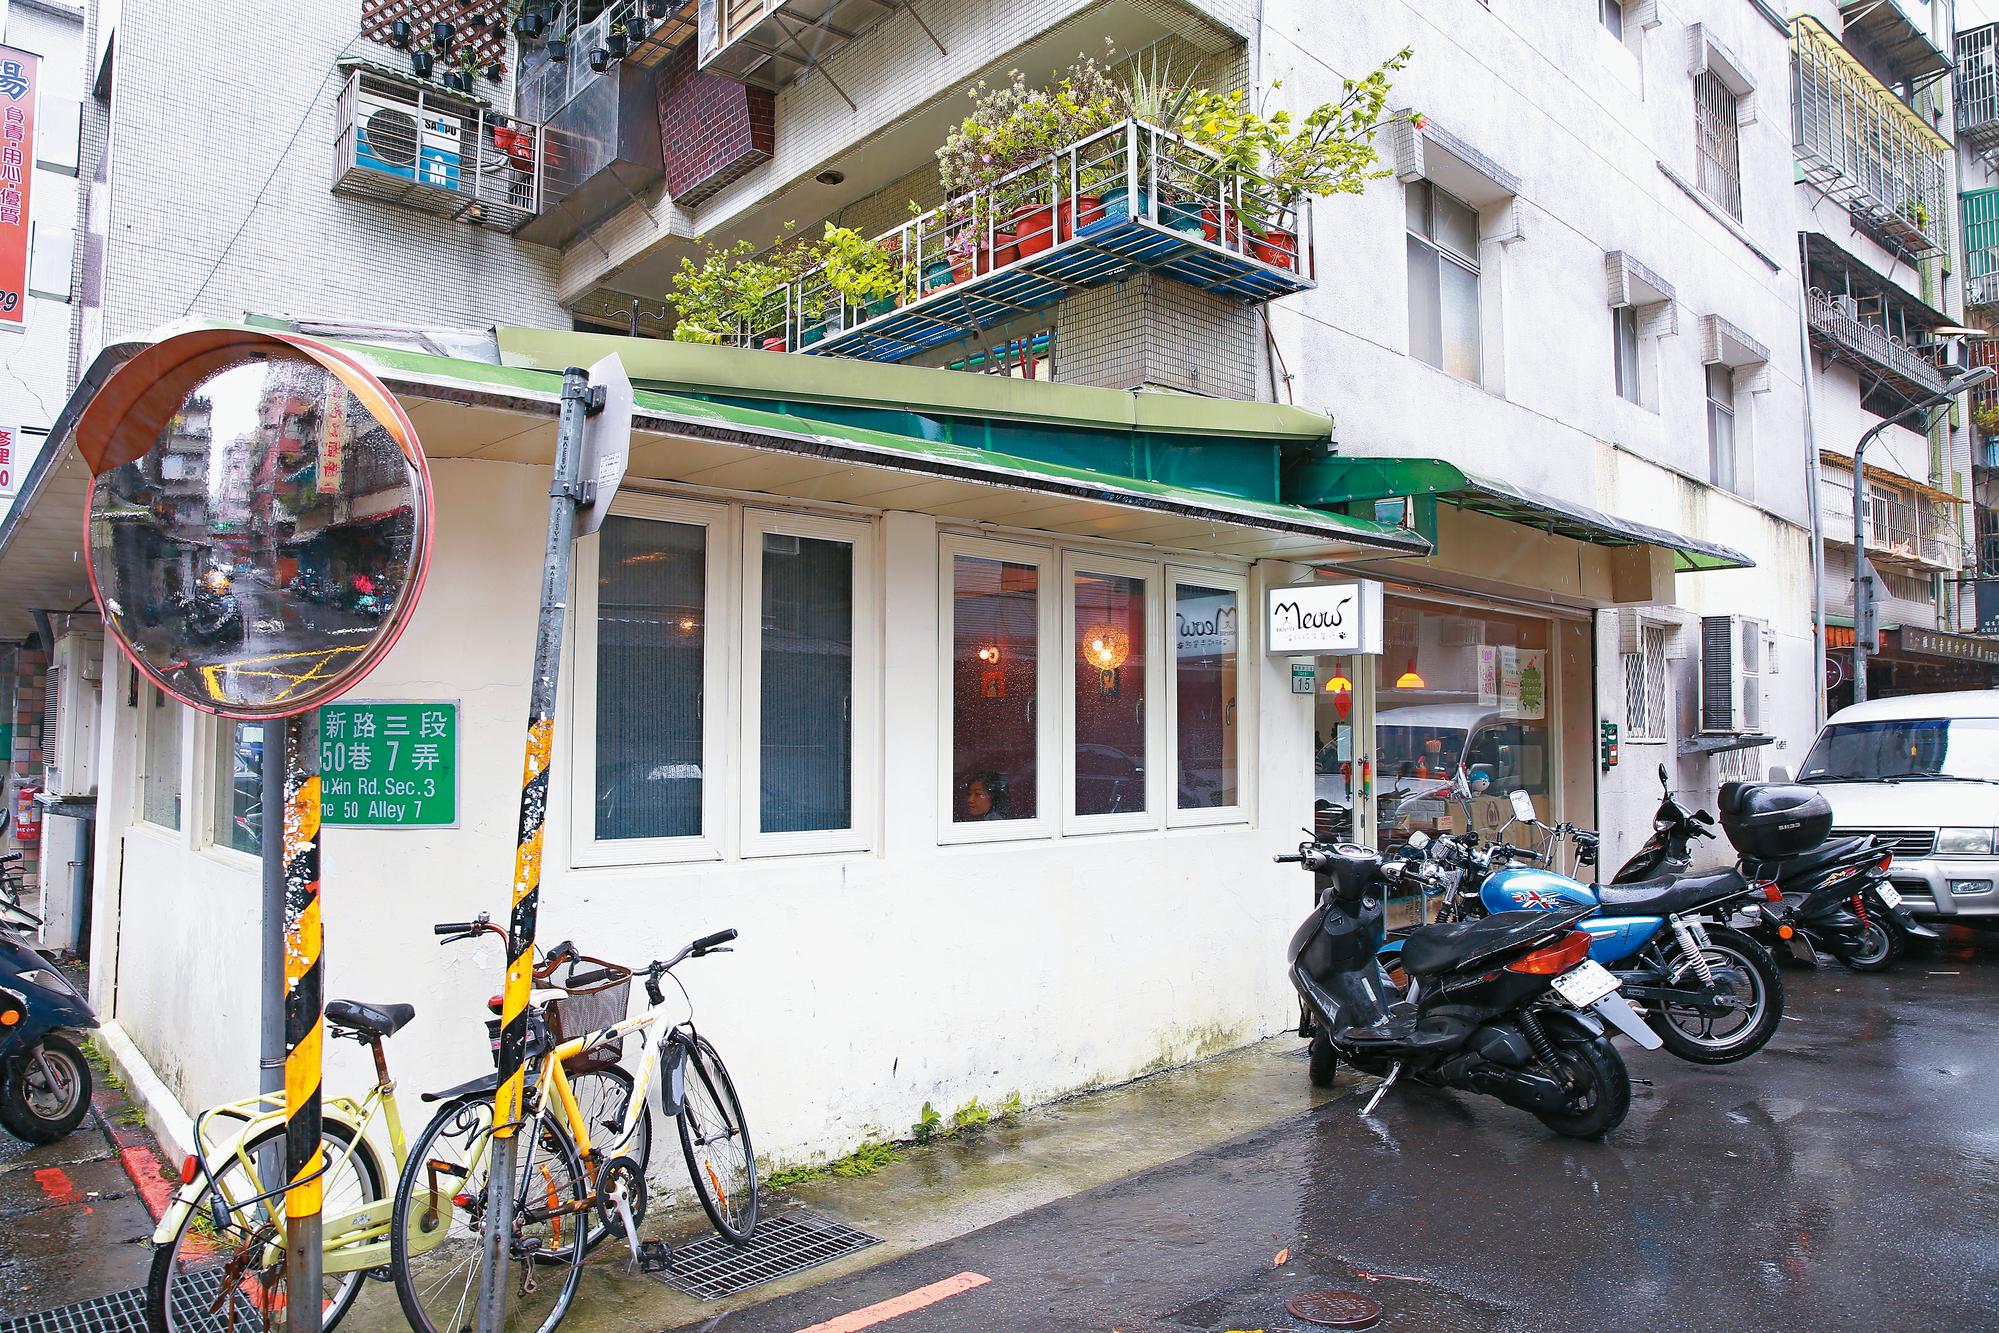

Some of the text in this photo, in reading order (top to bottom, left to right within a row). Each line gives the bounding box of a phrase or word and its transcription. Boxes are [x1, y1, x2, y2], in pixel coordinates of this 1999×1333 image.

[1274, 596, 1352, 629] Meow
[1298, 677, 1310, 691] 15
[326, 711, 447, 738] 新路三段
[321, 800, 422, 822] ne 50 Alley 7
